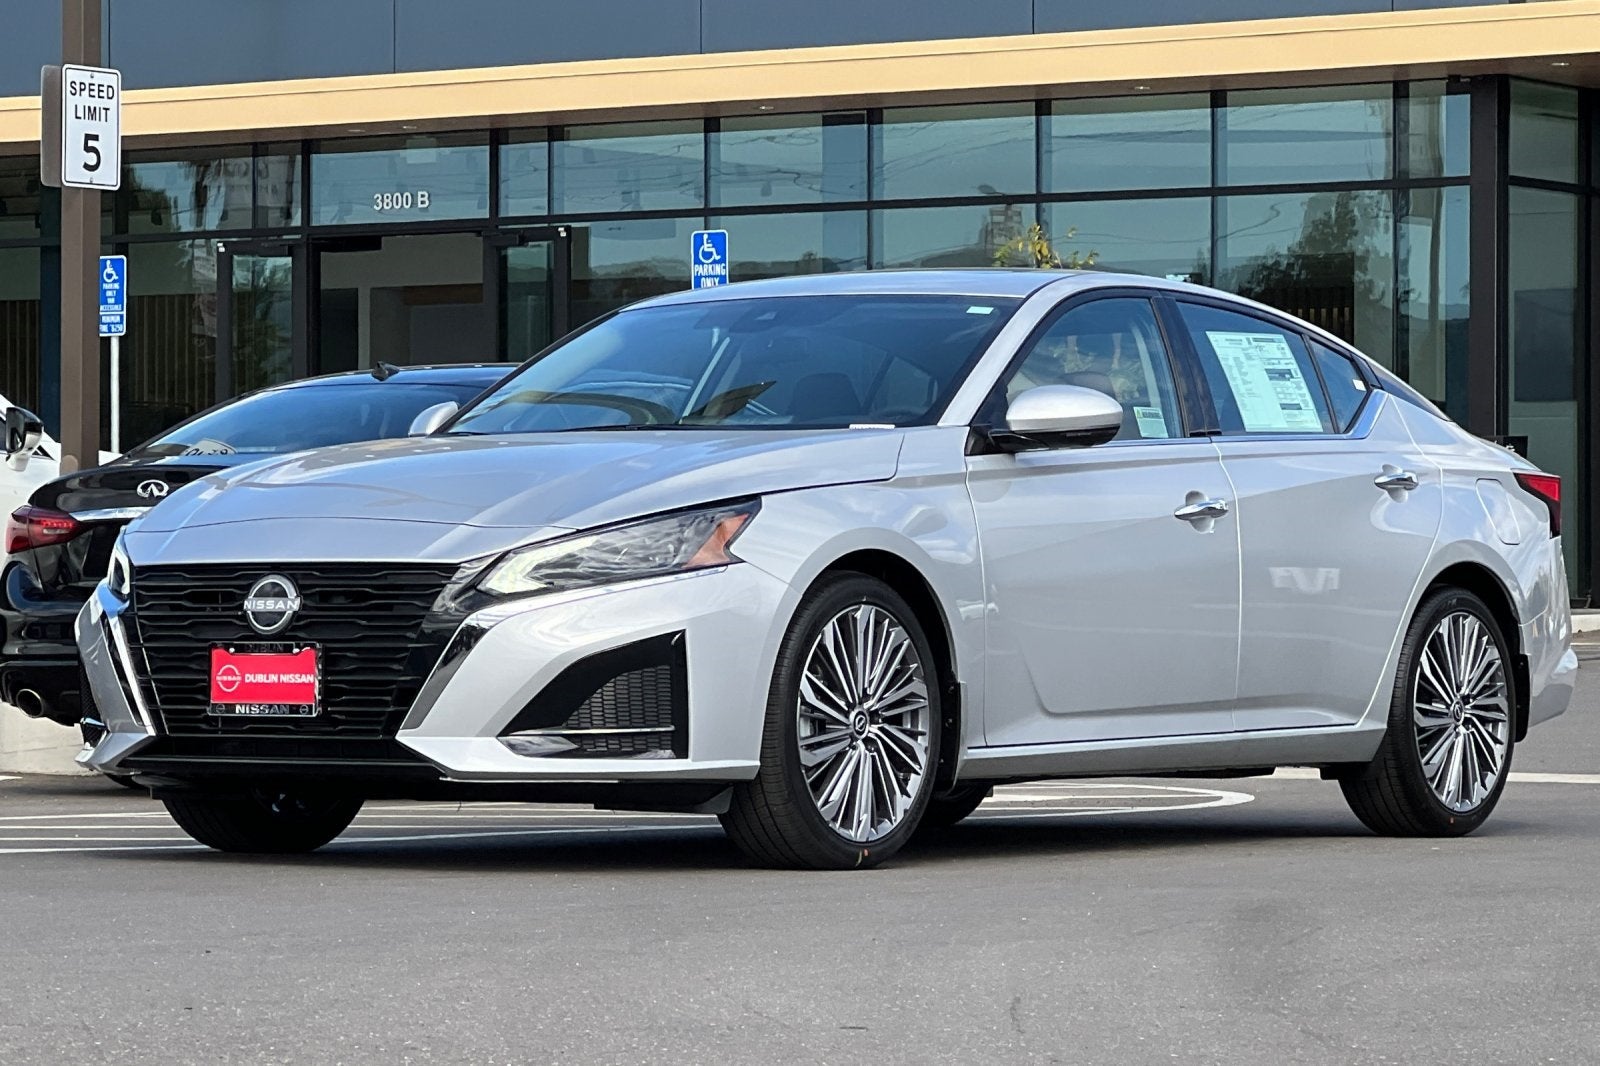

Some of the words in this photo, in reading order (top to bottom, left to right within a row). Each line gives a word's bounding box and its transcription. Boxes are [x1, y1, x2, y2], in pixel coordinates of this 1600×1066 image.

[69, 80, 115, 100] SPEED
[74, 104, 110, 122] LIMIT
[82, 133, 101, 172] 5
[373, 192, 412, 211] 3800
[417, 190, 430, 208] B
[694, 263, 726, 277] PARKING
[243, 599, 299, 610] NISSAN
[244, 674, 279, 683] DUBLIN
[279, 673, 314, 684] NISSAN
[235, 704, 290, 714] NISSAN
